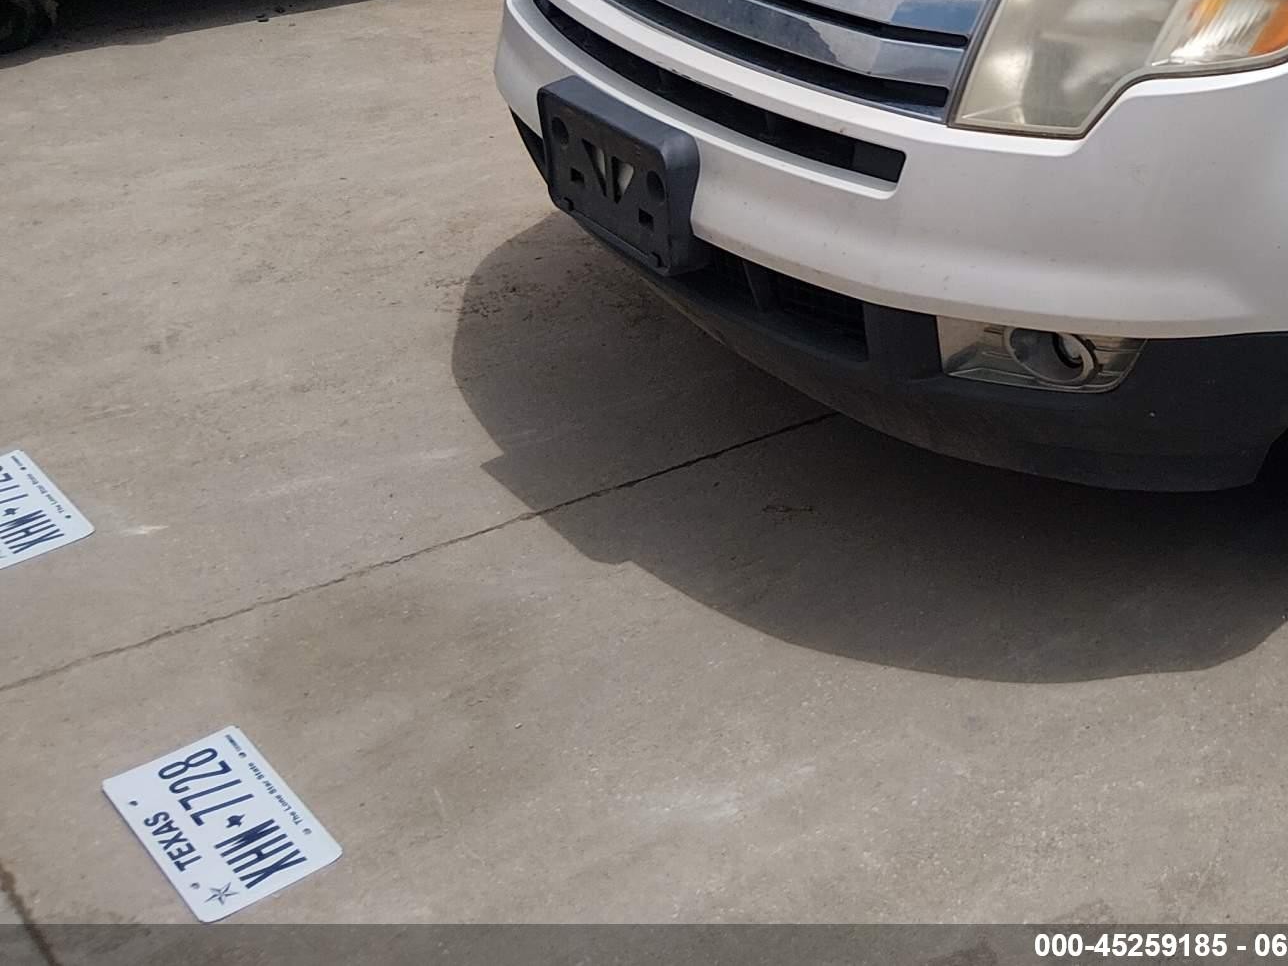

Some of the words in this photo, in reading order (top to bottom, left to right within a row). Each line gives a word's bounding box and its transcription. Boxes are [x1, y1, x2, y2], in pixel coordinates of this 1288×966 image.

[247, 761, 265, 780] State
[260, 778, 277, 794] Star
[274, 794, 293, 812] Lone
[287, 809, 303, 826] The
[143, 810, 203, 872] TEXAS
